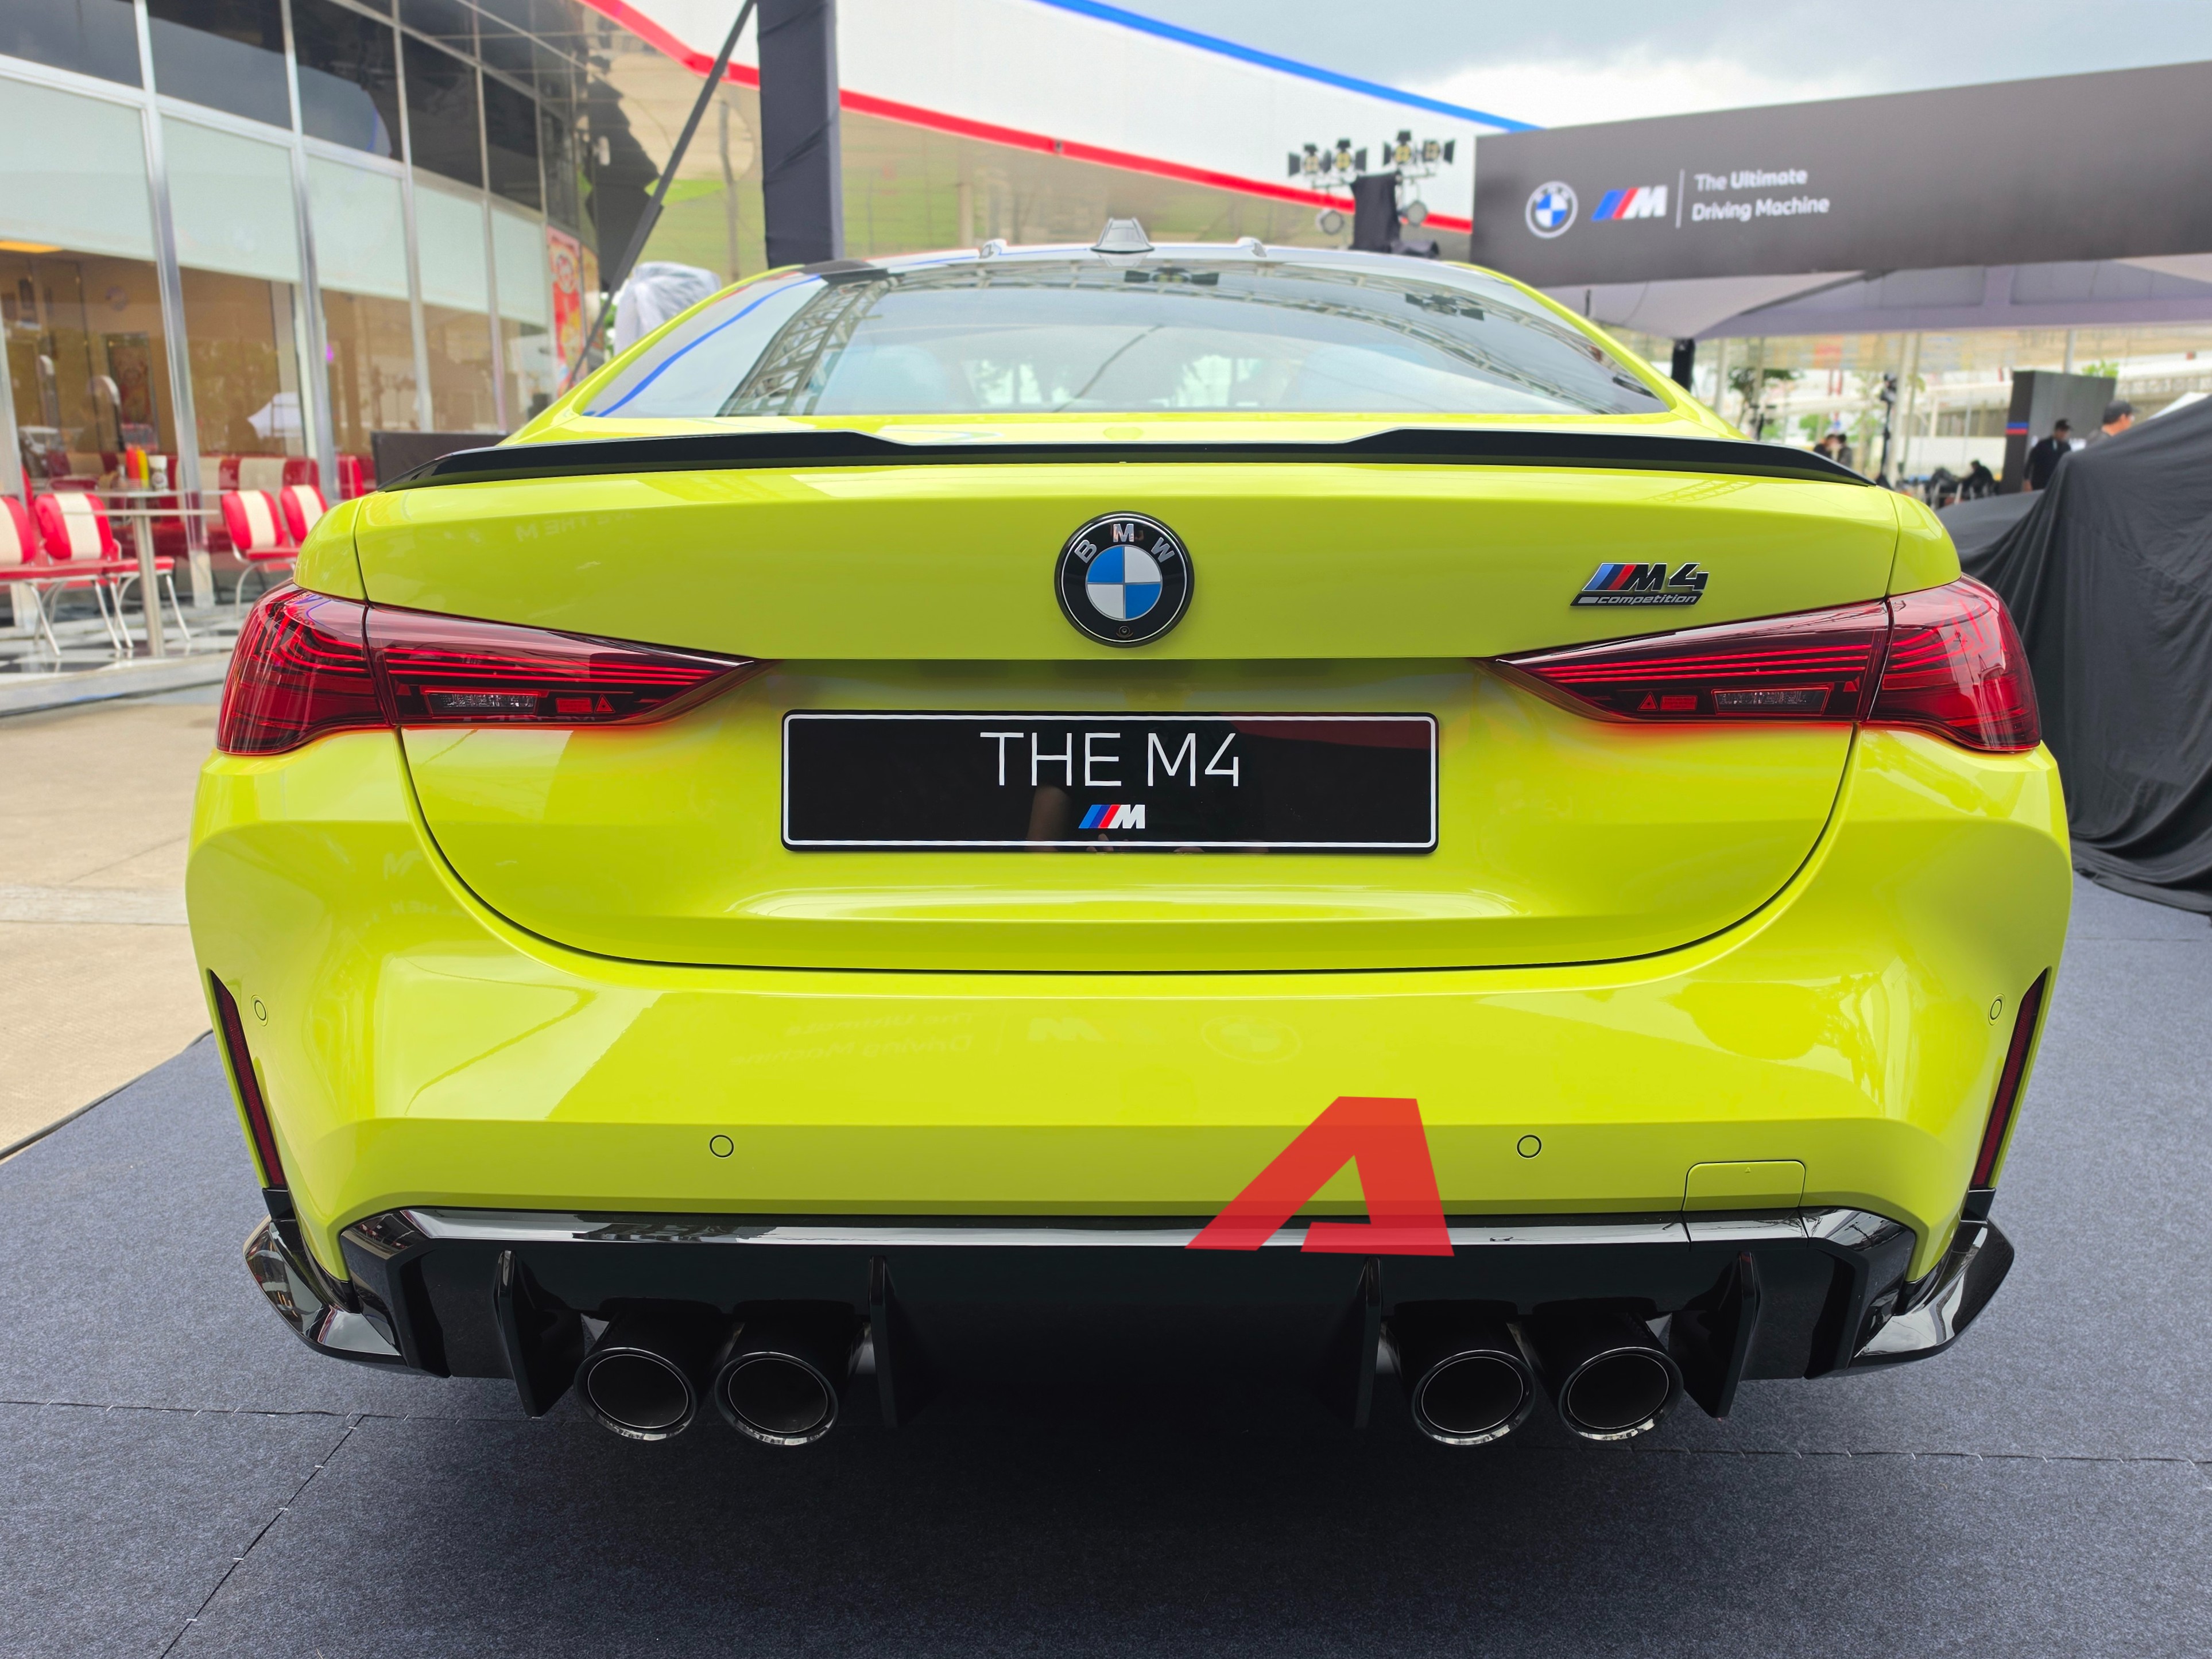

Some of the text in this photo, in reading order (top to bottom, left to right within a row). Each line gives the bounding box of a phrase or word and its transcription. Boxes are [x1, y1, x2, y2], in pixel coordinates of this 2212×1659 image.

[1694, 169, 1808, 192] The Ultimate
[1692, 196, 1830, 222] Driving Machine
[1074, 523, 1175, 564] BMW
[1618, 563, 1710, 591] M4
[1597, 594, 1697, 605] competition
[980, 732, 1238, 786] THE M4
[1107, 804, 1145, 829] M
